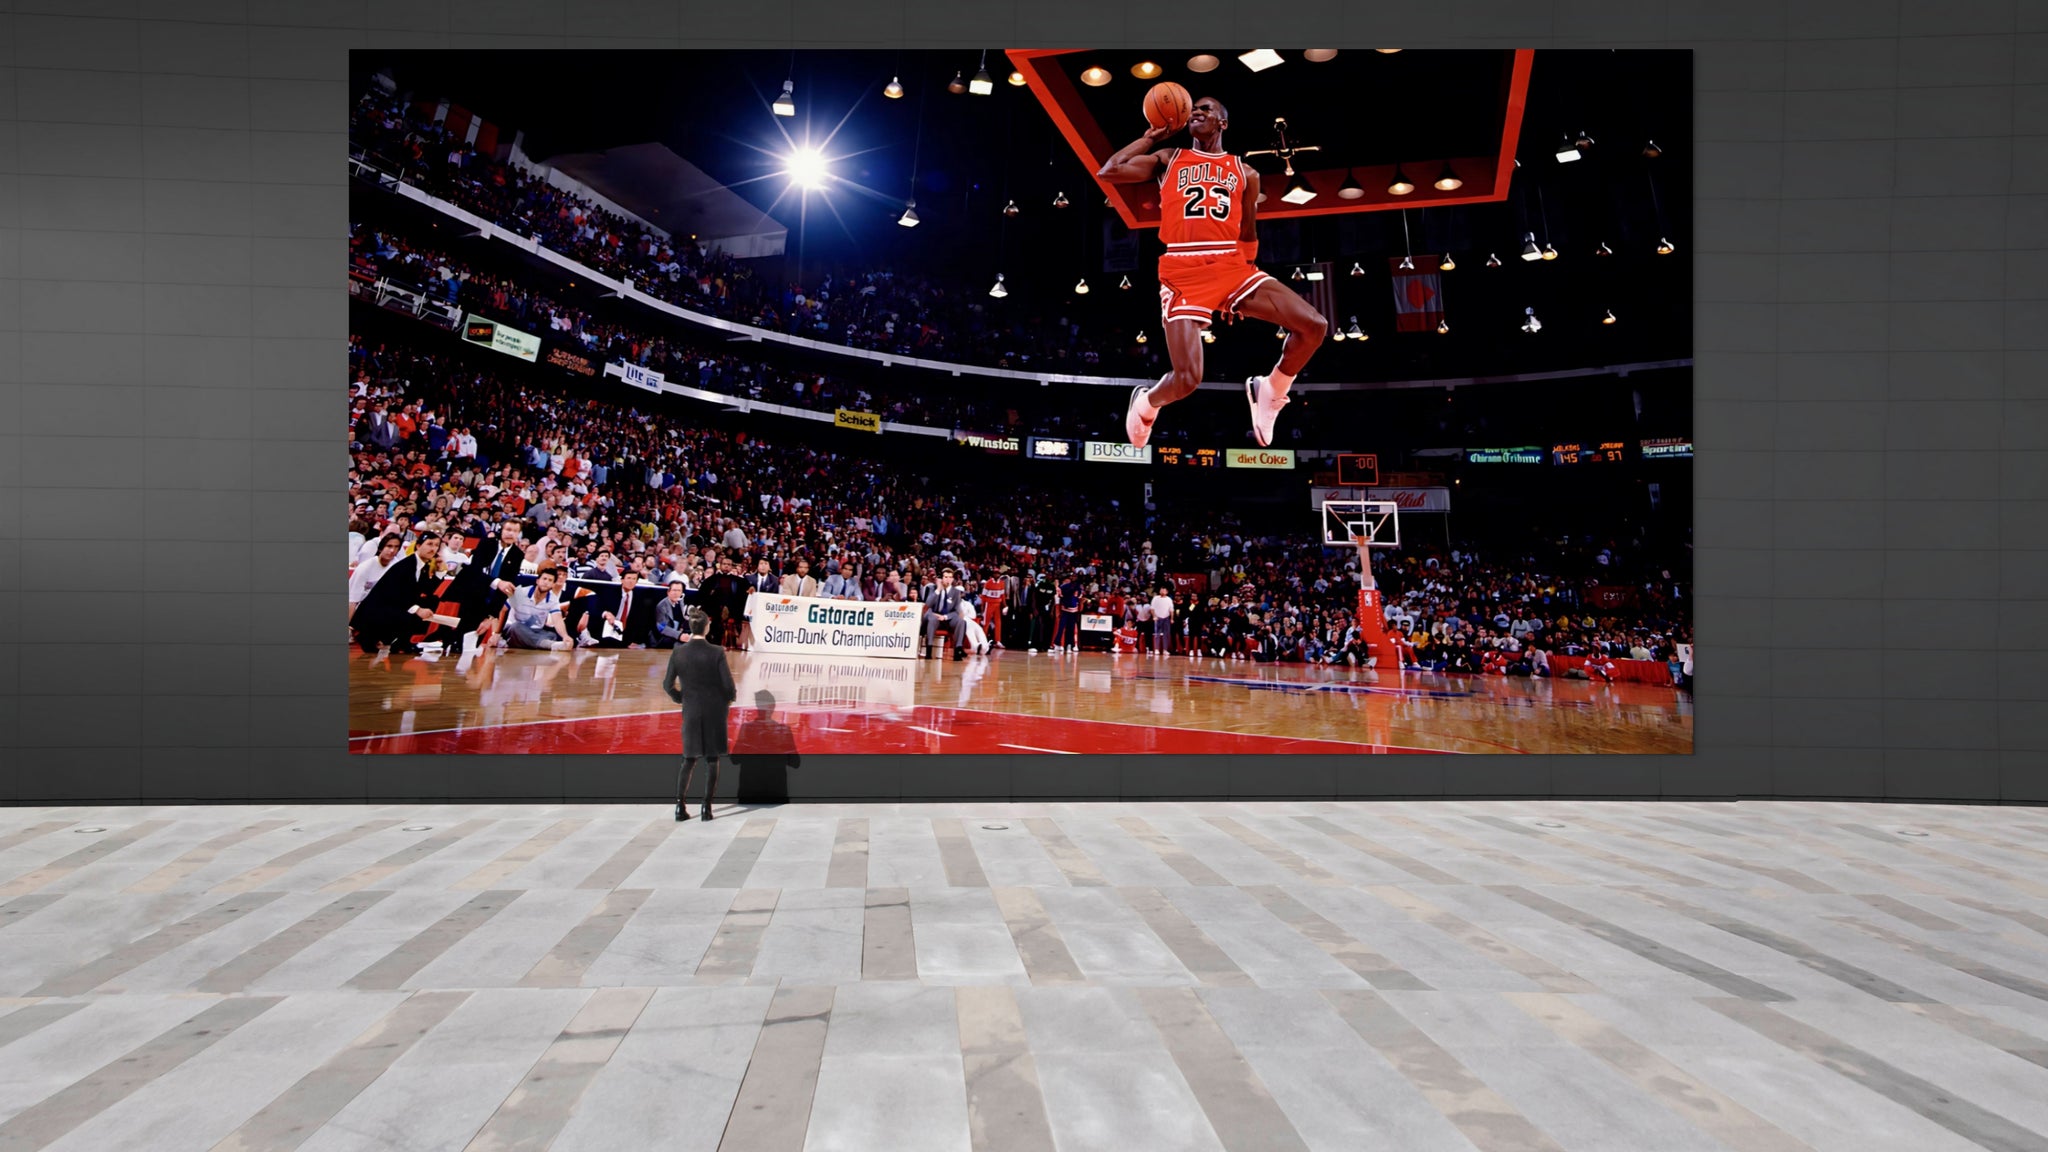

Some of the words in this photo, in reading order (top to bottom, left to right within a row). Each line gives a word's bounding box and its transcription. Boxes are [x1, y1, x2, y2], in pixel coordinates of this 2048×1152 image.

[1177, 162, 1238, 193] BULLS
[1183, 185, 1231, 222] 23
[626, 366, 644, 381] Lite
[839, 412, 875, 428] Schick
[967, 435, 1019, 451] Winston
[1092, 443, 1144, 458] BUSCH
[1163, 455, 1178, 465] 145
[1201, 457, 1214, 467] 97
[1237, 454, 1257, 465] diet
[1260, 453, 1288, 465] Coke
[1560, 453, 1578, 464] 145
[1607, 451, 1622, 461] 97
[765, 602, 799, 612] Gatorade
[884, 609, 915, 619] Gatorade
[808, 604, 874, 626] Gatorade
[764, 625, 828, 645] Slam-Dunk
[832, 629, 911, 652] Championship
